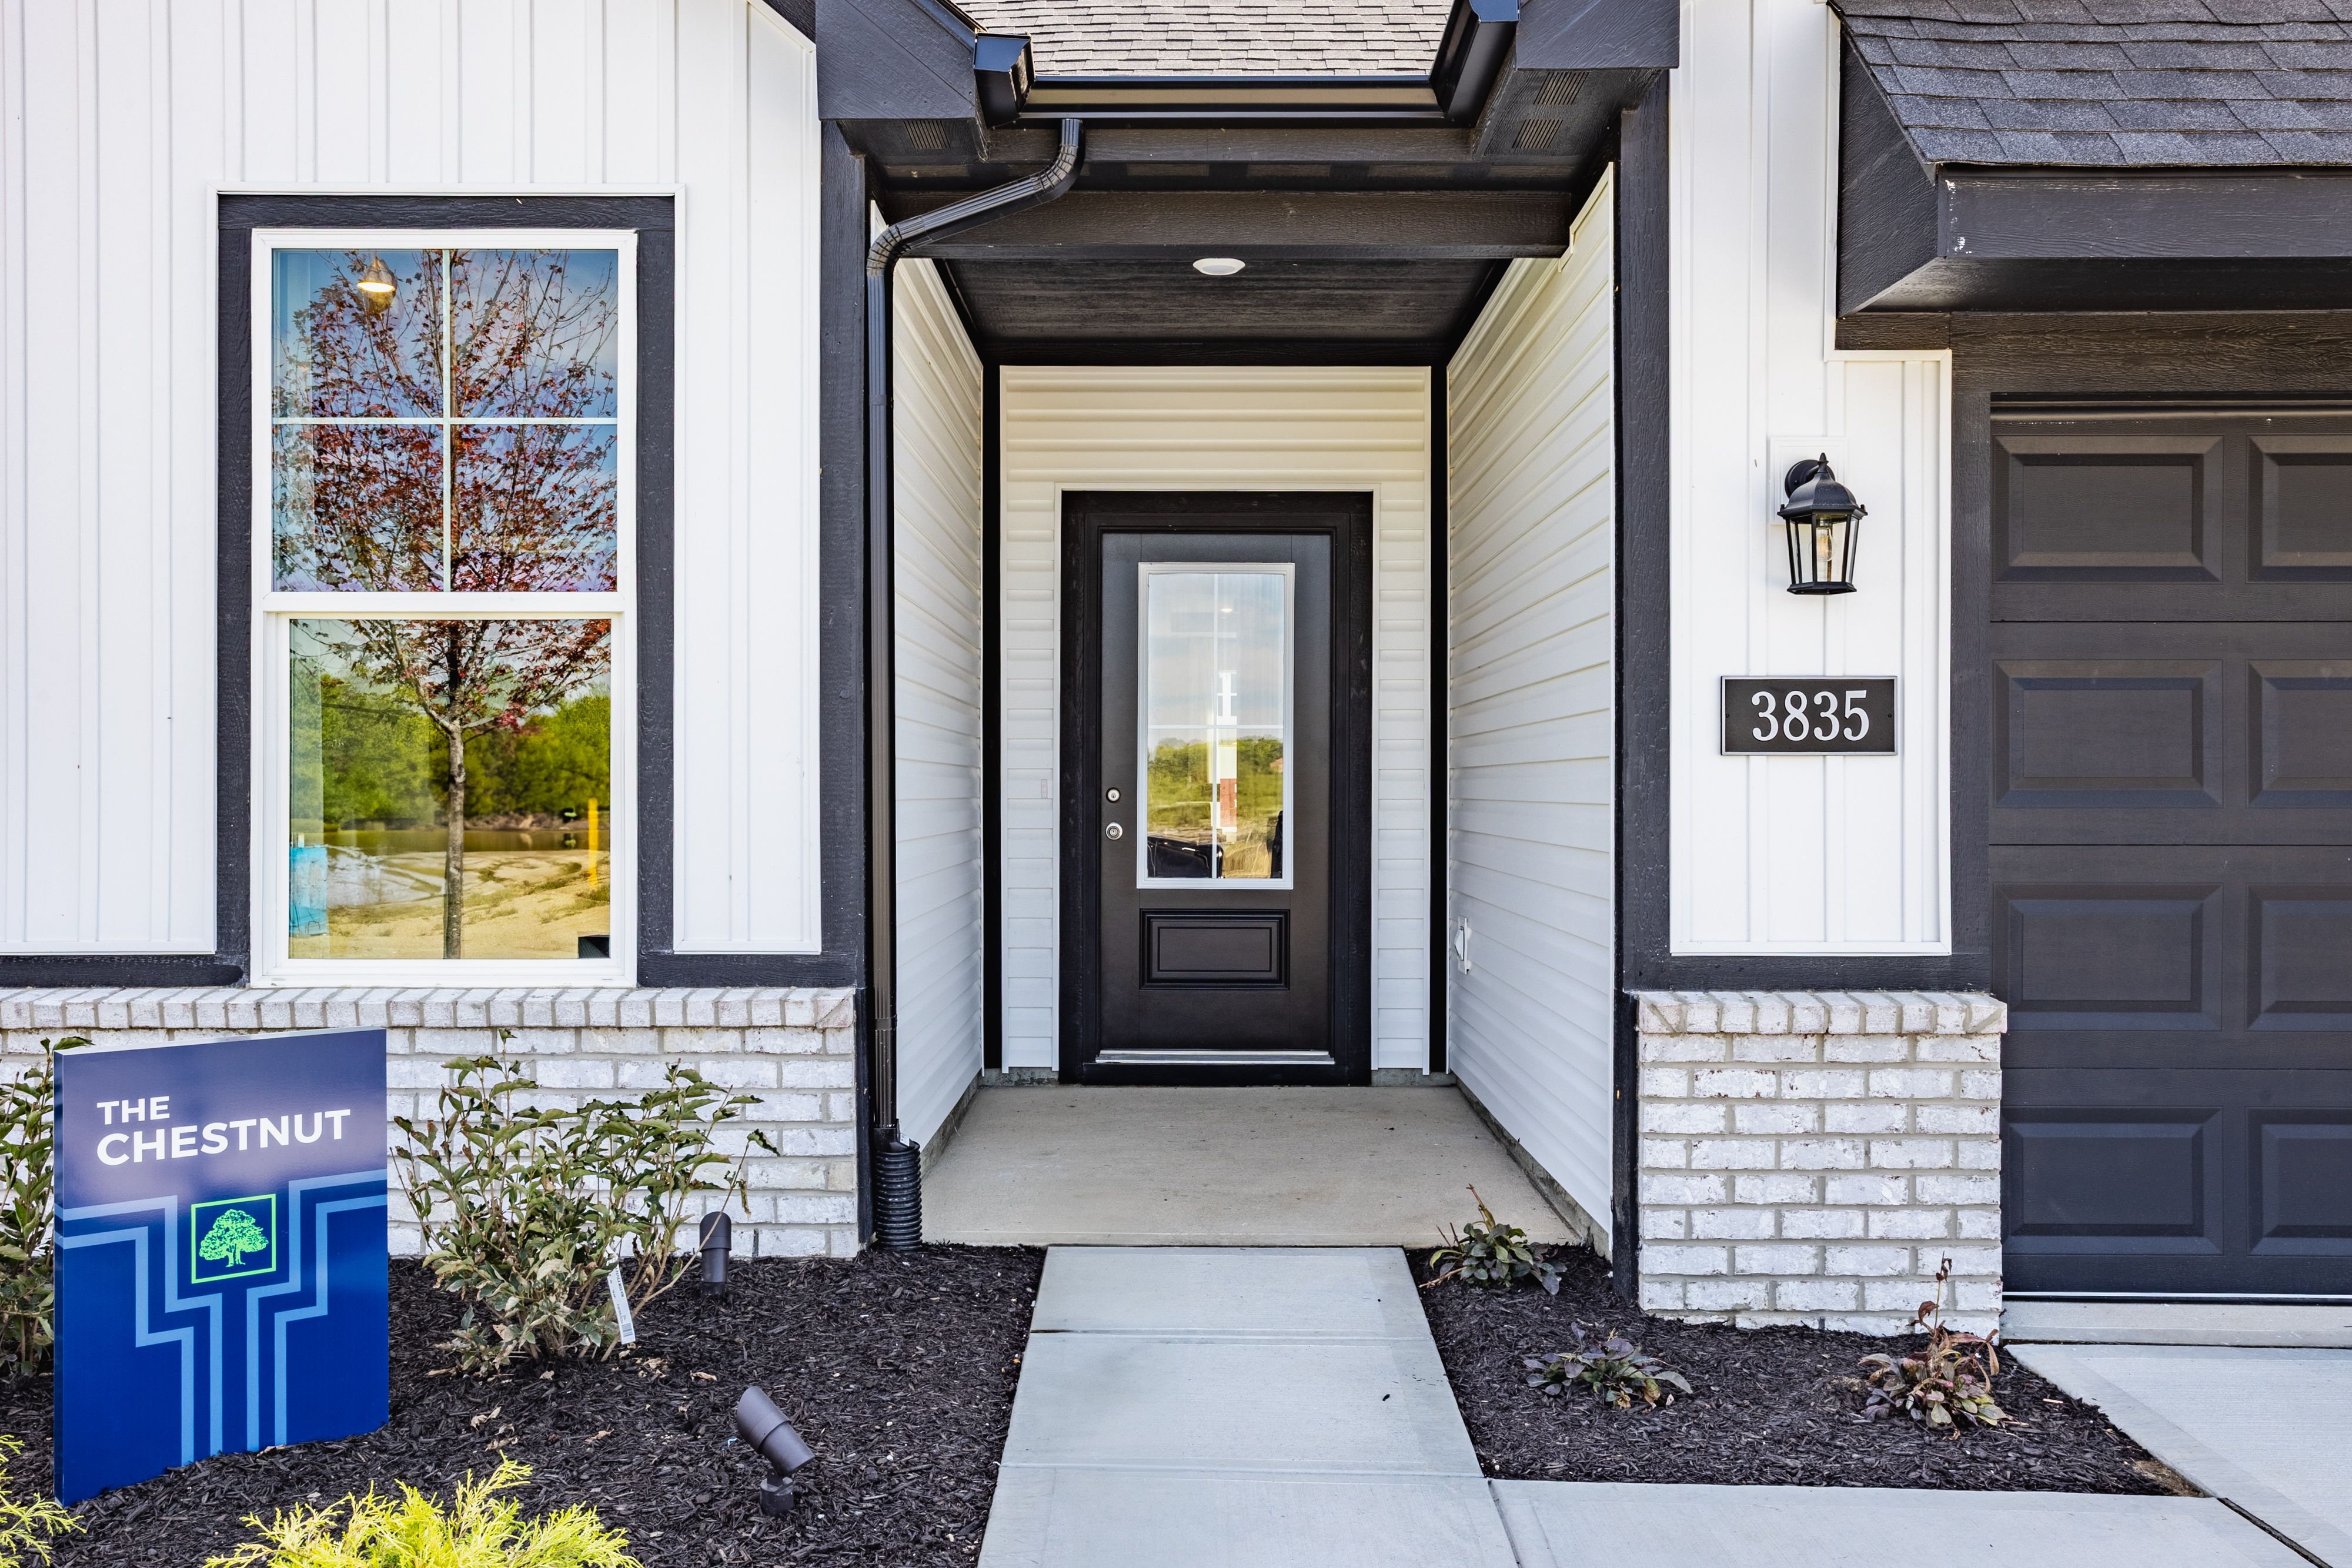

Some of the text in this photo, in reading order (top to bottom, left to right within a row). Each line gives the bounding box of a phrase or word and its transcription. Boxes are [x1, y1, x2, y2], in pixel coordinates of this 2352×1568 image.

[1751, 690, 1870, 741] 3835
[96, 1096, 170, 1125] THE
[96, 1109, 351, 1166] CHESTNUT
